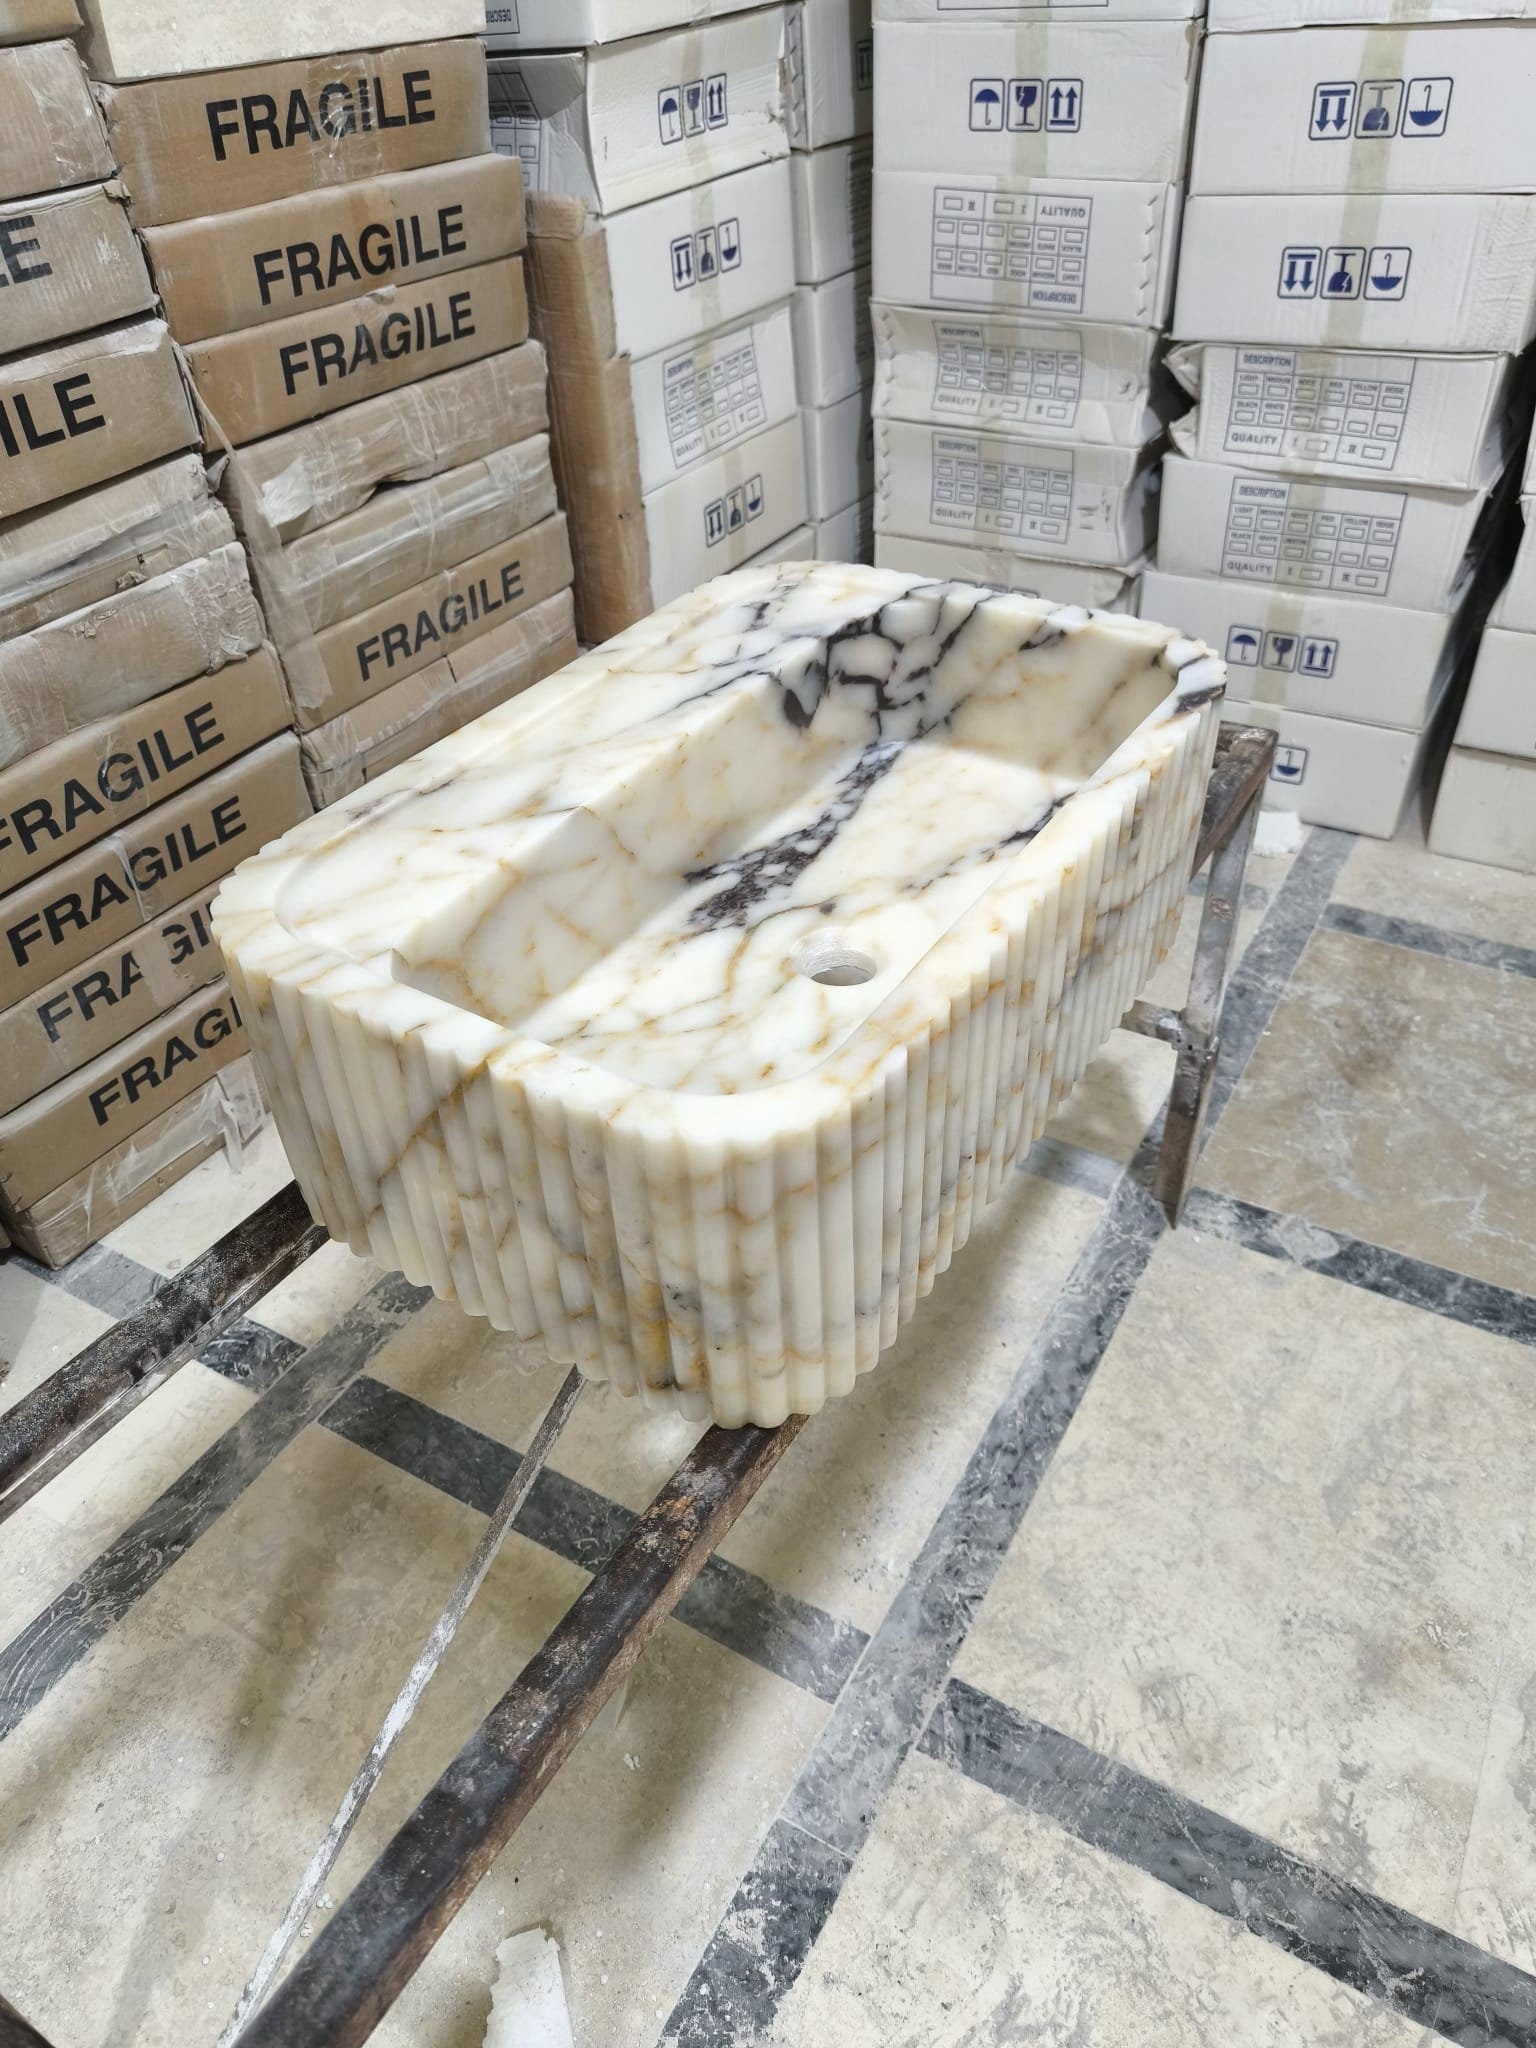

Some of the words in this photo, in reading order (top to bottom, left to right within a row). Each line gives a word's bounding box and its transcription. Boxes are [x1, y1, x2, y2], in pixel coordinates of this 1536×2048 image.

[206, 70, 436, 161] FRAGILE
[1040, 205, 1086, 218] QUALITY
[254, 205, 467, 305] FRAGILE
[1033, 291, 1077, 304] DESCRIPTION
[280, 292, 475, 395] FRAGILE
[1243, 354, 1291, 367] DESCRIPTION
[1231, 433, 1277, 445] QUALITY
[935, 508, 973, 520] QUALITY
[1239, 486, 1286, 499] DESCRIPTION
[1227, 561, 1272, 575] QUALITY
[357, 561, 524, 681] FRAGILE
[6, 795, 247, 967] FRAGILE
[36, 903, 213, 1044] FRAGI
[89, 996, 243, 1126] FRAGI
